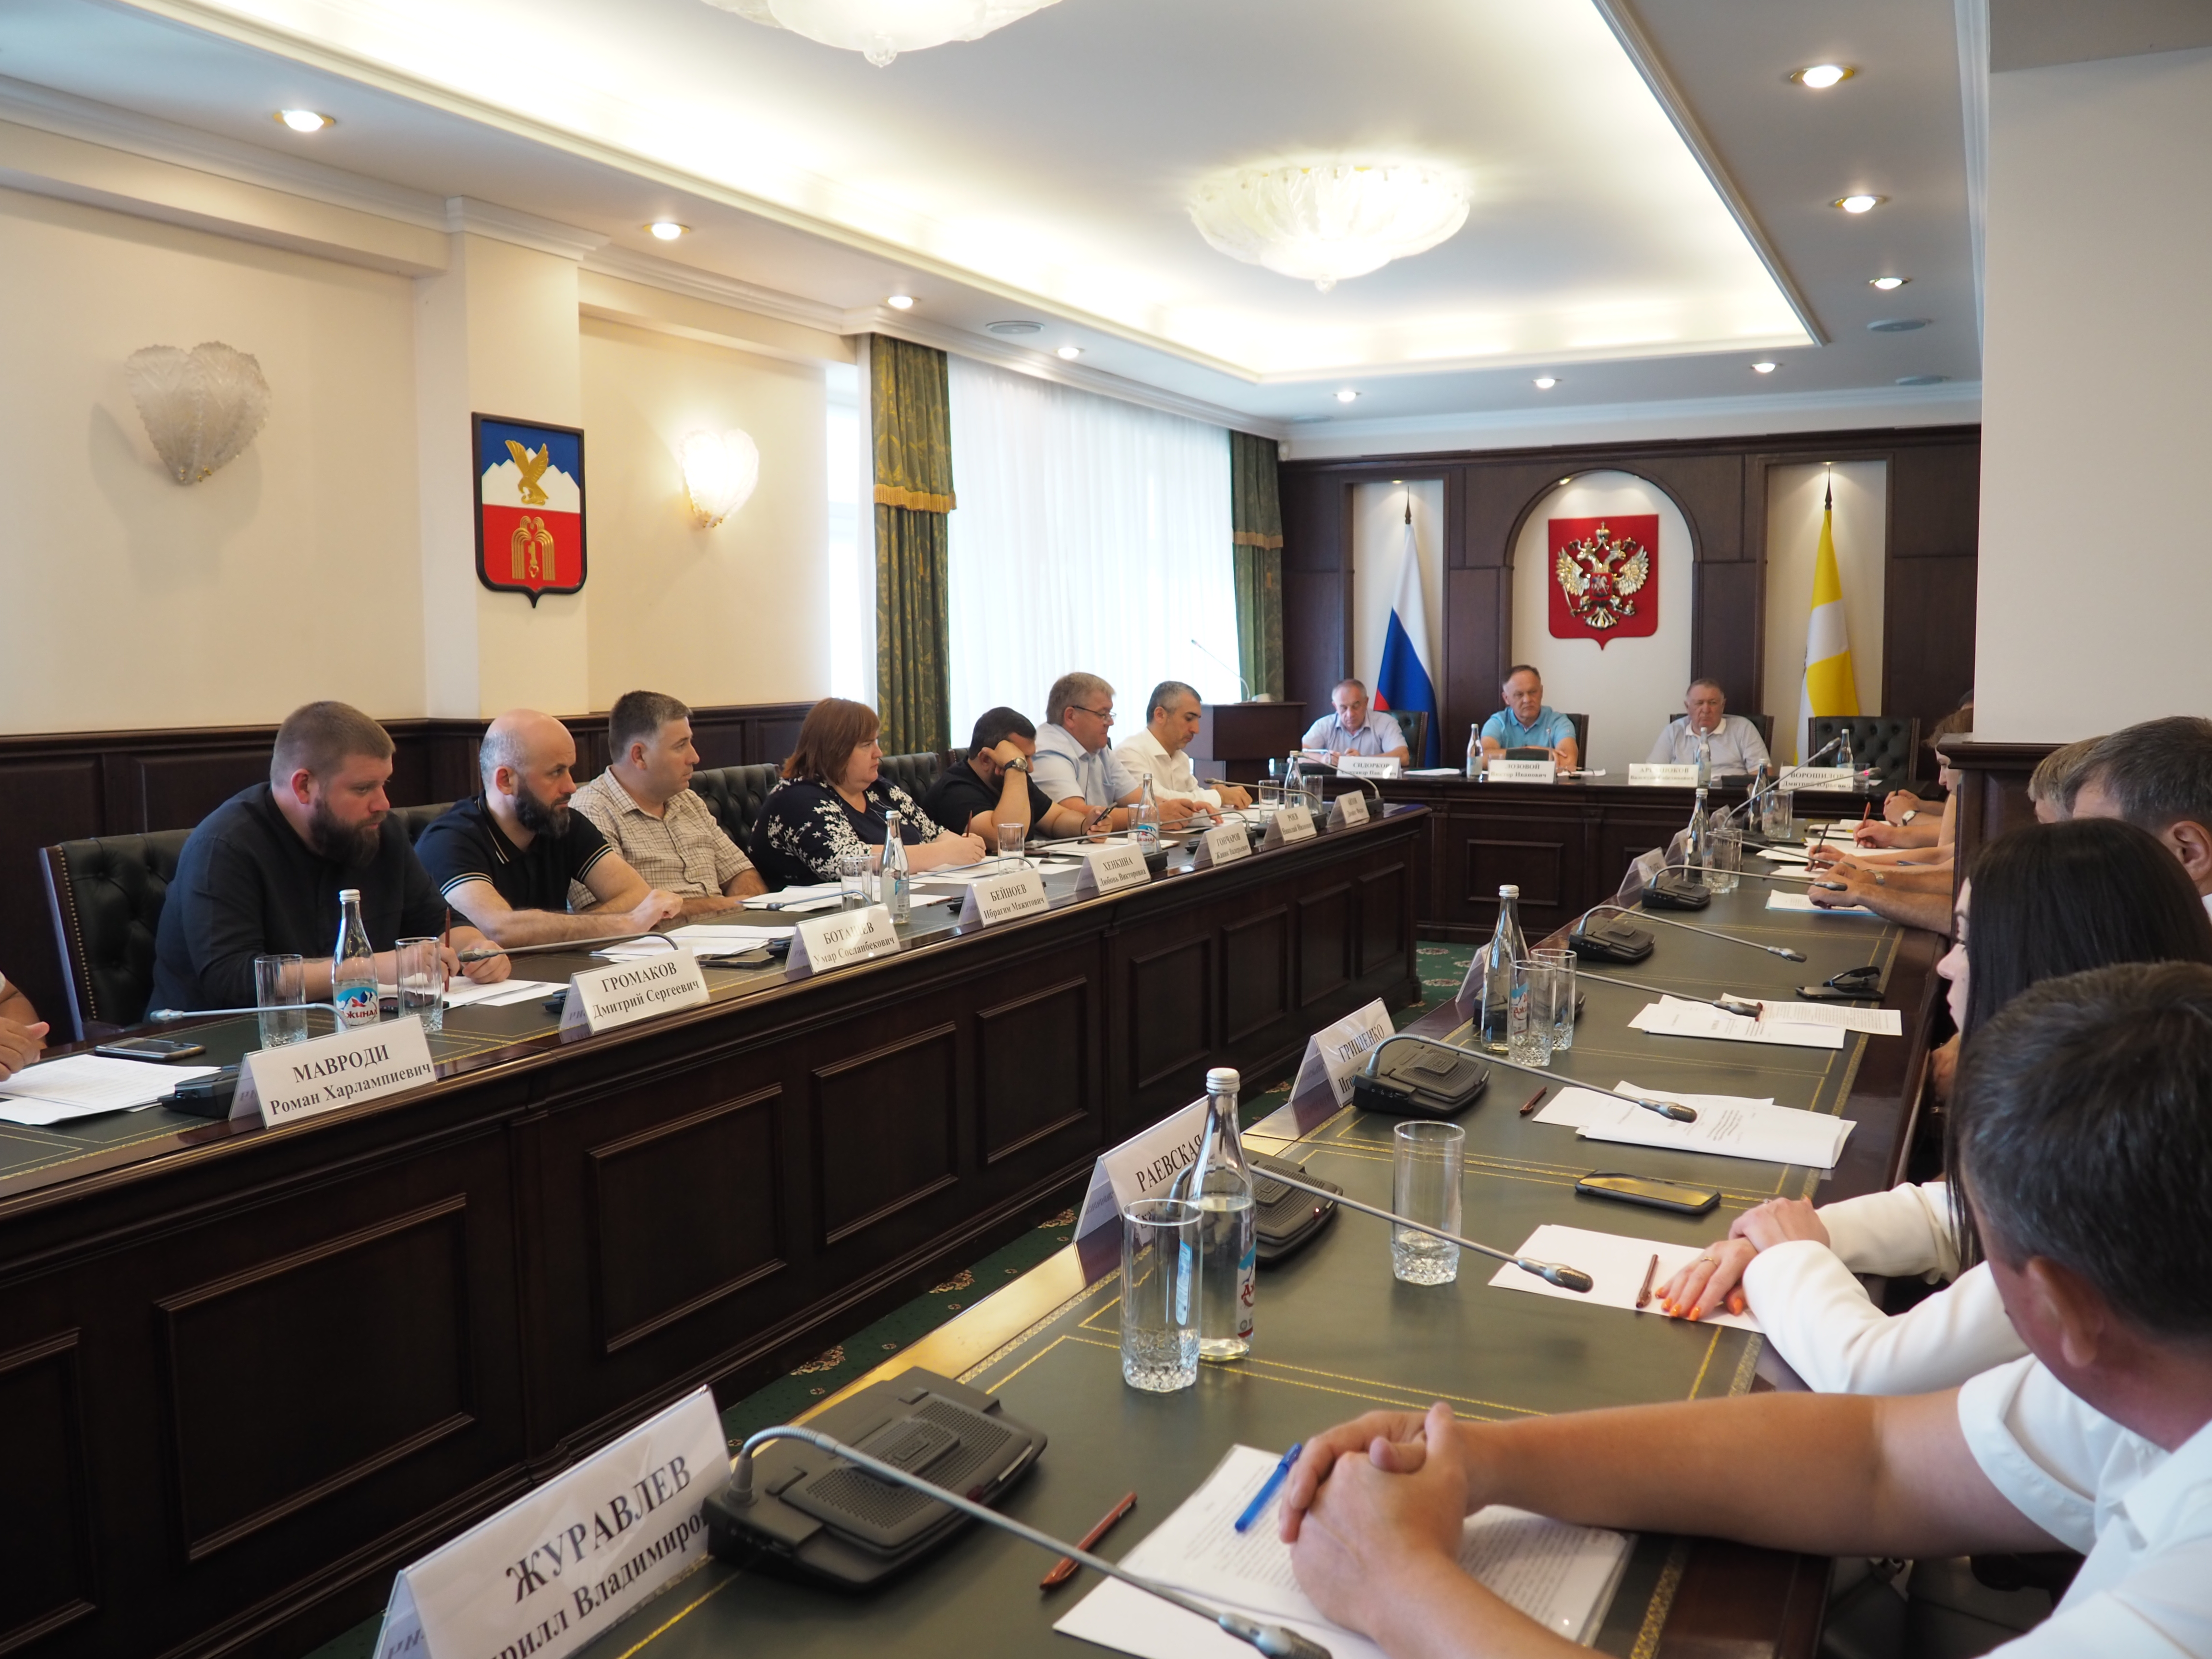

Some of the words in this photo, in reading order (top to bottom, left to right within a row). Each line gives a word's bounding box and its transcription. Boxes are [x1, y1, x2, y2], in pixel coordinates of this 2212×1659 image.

[1216, 832, 1241, 847] ГОНЧАРОВ
[1100, 876, 1119, 887] Любовь
[1118, 868, 1146, 881] Викторовна
[1103, 856, 1133, 872] ХЕНКИНА
[984, 905, 1011, 919] Ибрагим
[1011, 897, 1045, 912] Мажитович
[990, 884, 1027, 902] БЕЙНОЕВ
[813, 952, 837, 965] Умар
[838, 937, 895, 958] Сосланбекович
[600, 962, 677, 993] ГРОМАКОВ
[592, 994, 645, 1020] Дмитрий
[646, 980, 700, 1002] Сергеевич
[1338, 1024, 1385, 1063] ГРИЩЕНКО
[292, 1044, 390, 1083] МАВРОДИ
[270, 1092, 320, 1116] Роман
[323, 1062, 432, 1101] Харлампиевич
[1338, 1075, 1355, 1094] Иго
[1135, 1133, 1202, 1193] РАЕВСКАЯ
[505, 1455, 691, 1604] ЖУРАВЛЕВ
[492, 1609, 570, 1659] рилл
[572, 1509, 708, 1619] Владимиро
